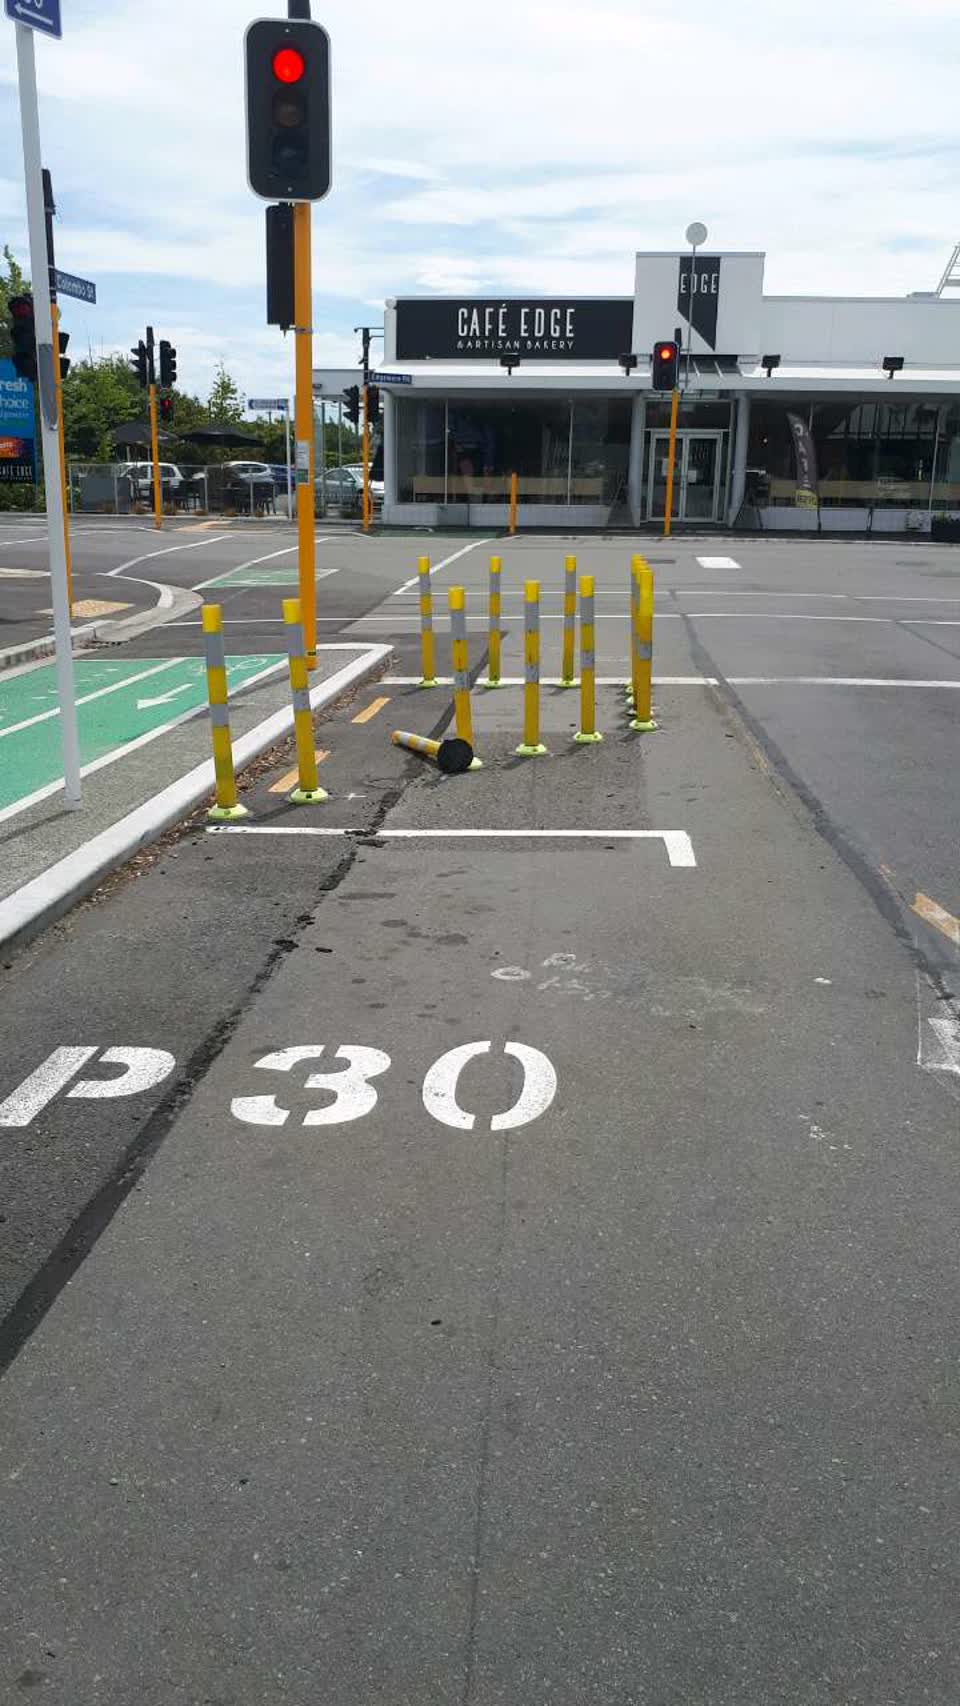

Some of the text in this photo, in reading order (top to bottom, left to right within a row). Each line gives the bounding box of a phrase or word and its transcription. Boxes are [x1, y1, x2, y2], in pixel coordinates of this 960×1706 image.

[680, 273, 720, 294] EDGE
[458, 303, 576, 338] CAFÉ EDGE
[526, 341, 574, 350] BAKERY
[0, 377, 27, 393] resh
[0, 394, 29, 409] hoice
